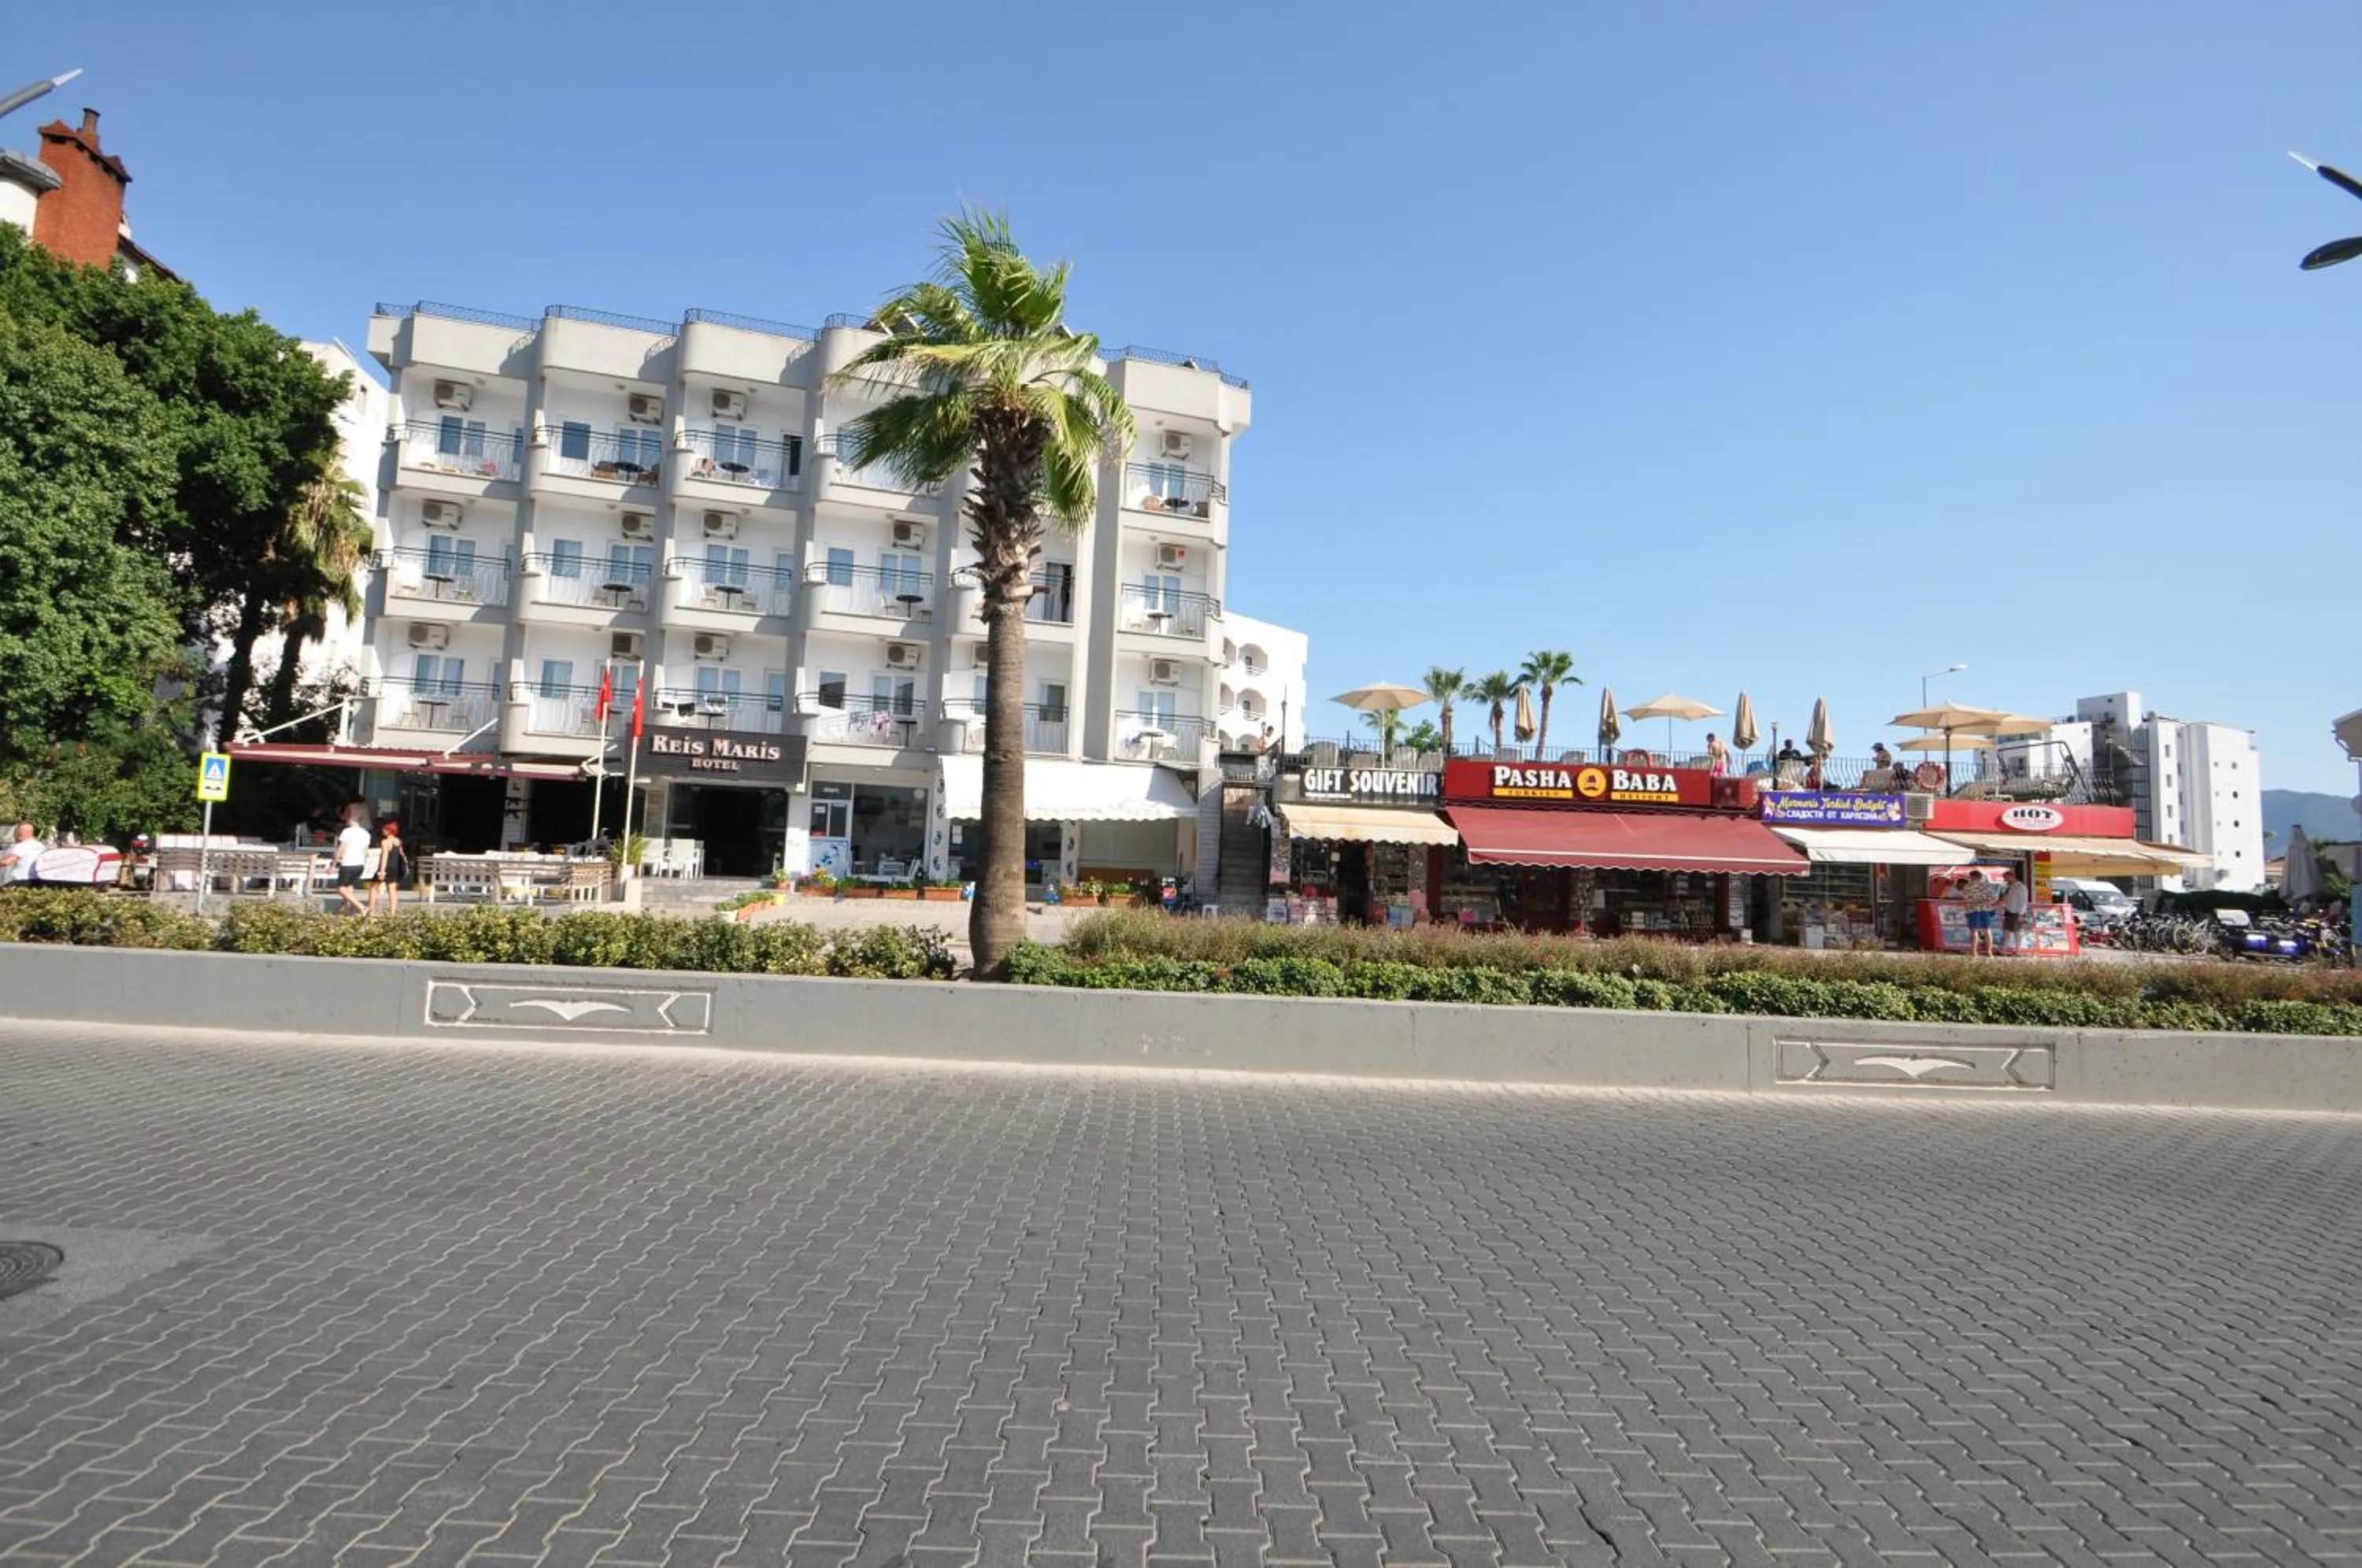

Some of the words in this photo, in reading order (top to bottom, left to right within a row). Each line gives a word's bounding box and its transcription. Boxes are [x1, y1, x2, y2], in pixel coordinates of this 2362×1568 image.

[692, 758, 740, 771] HOTEL
[1304, 767, 1344, 791] GIFT
[1349, 770, 1438, 796] SOUVENIR
[1494, 765, 1572, 788] PASHA
[1612, 769, 1678, 792] BABA
[2013, 809, 2053, 819] HOT
